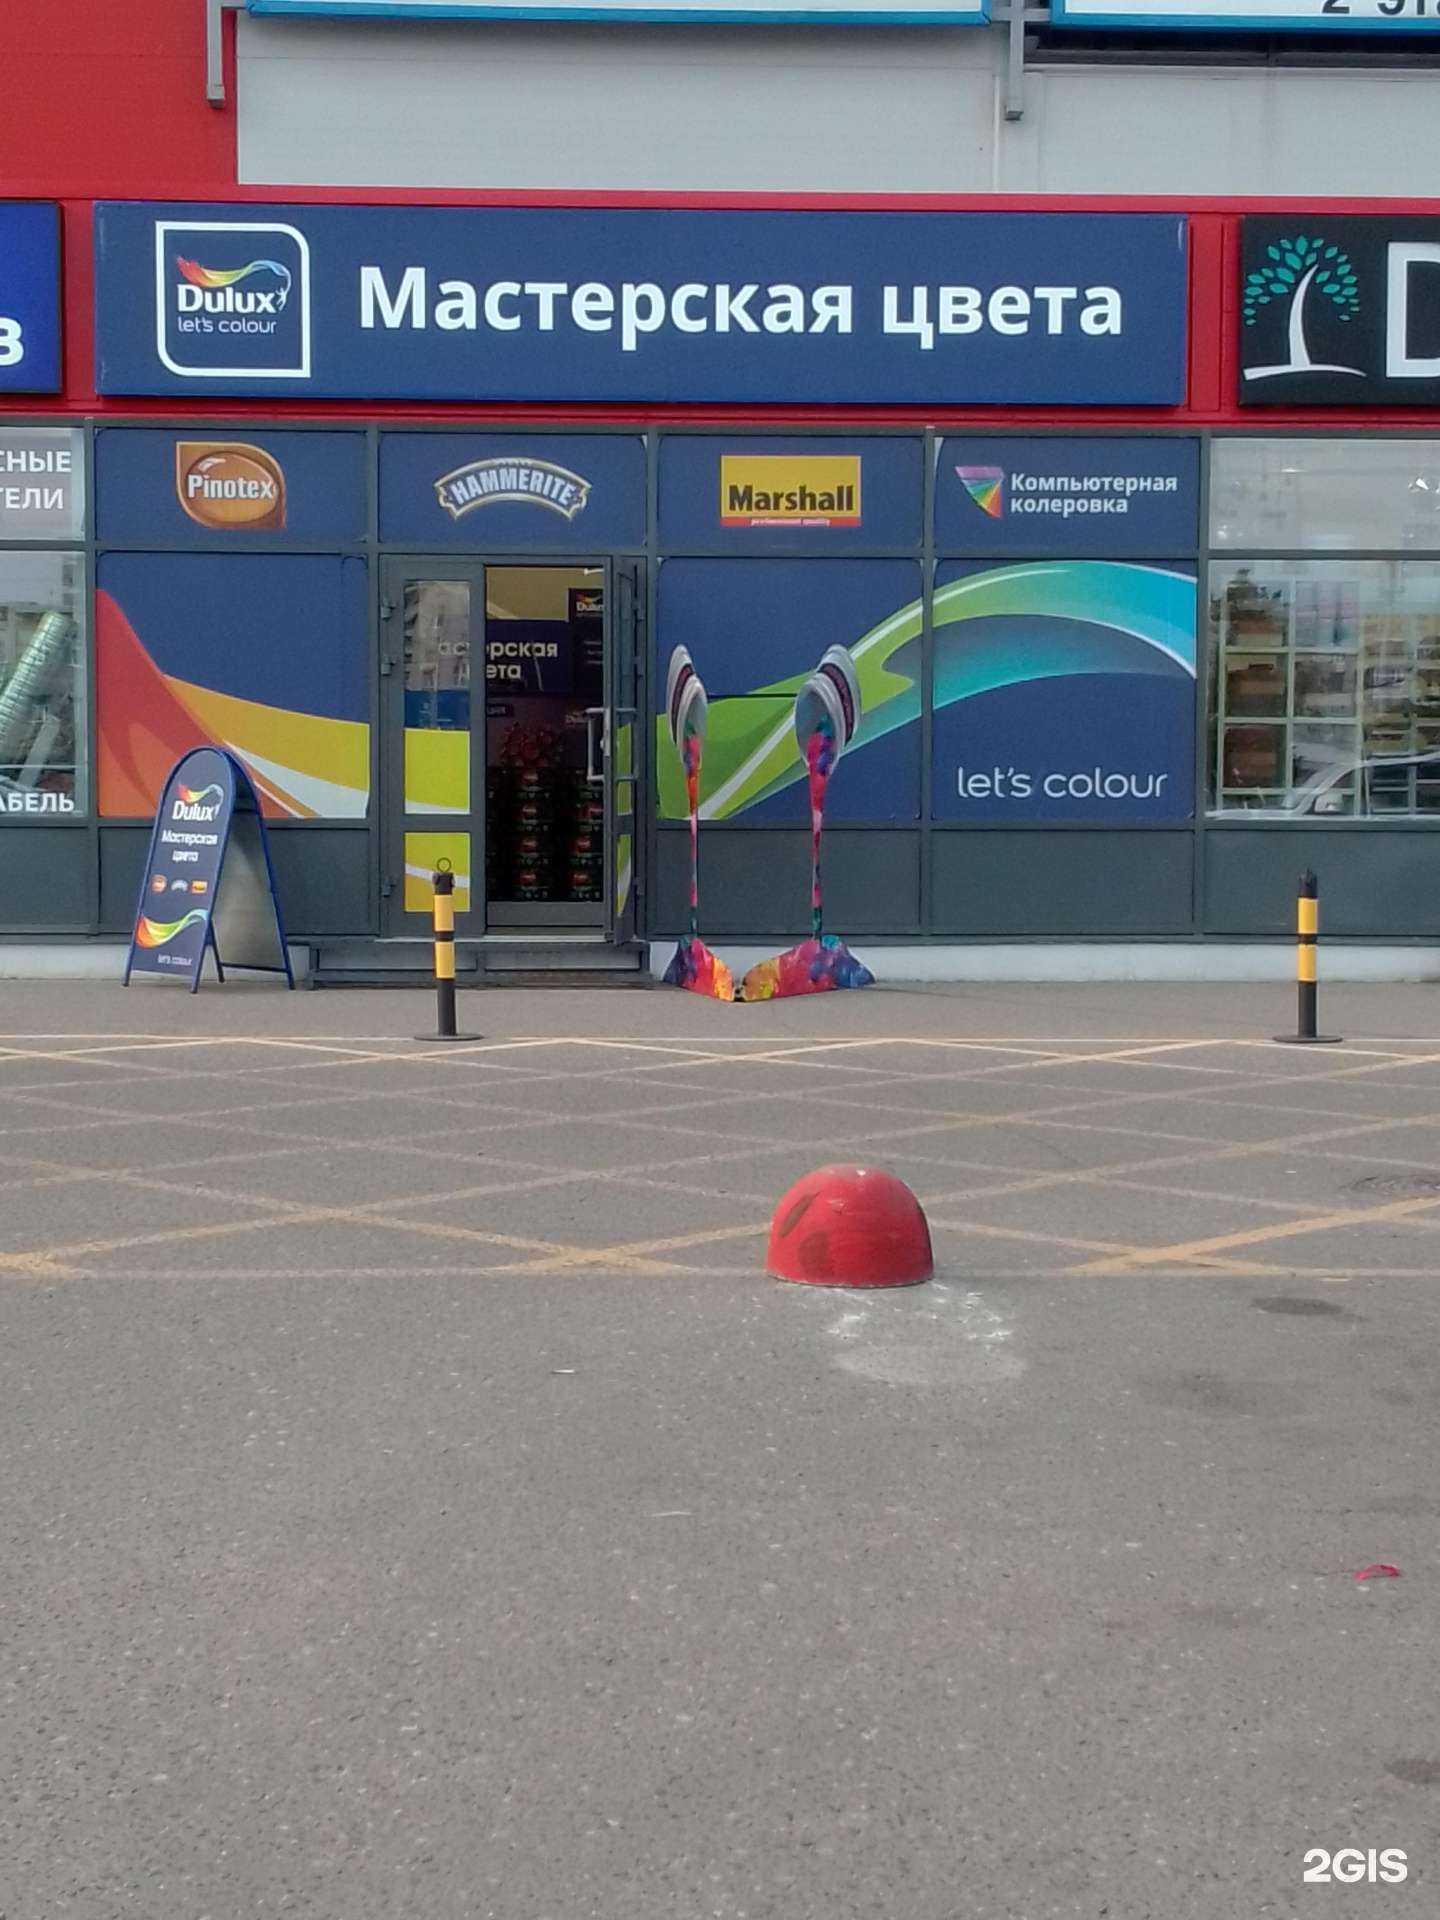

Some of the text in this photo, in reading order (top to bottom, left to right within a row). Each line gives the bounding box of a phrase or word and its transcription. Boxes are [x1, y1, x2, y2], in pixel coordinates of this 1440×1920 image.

[177, 283, 276, 313] Dulux
[359, 266, 1123, 351] Мастерская цвета
[218, 317, 277, 333] colour
[187, 474, 275, 499] Pinotex
[450, 467, 577, 506] HAMMERITE
[1011, 472, 1178, 496] Компьютерная
[728, 484, 854, 511] Marshall
[1010, 498, 1128, 518] колеровка
[957, 766, 1169, 798] let's colour
[172, 800, 213, 821] Dulux
